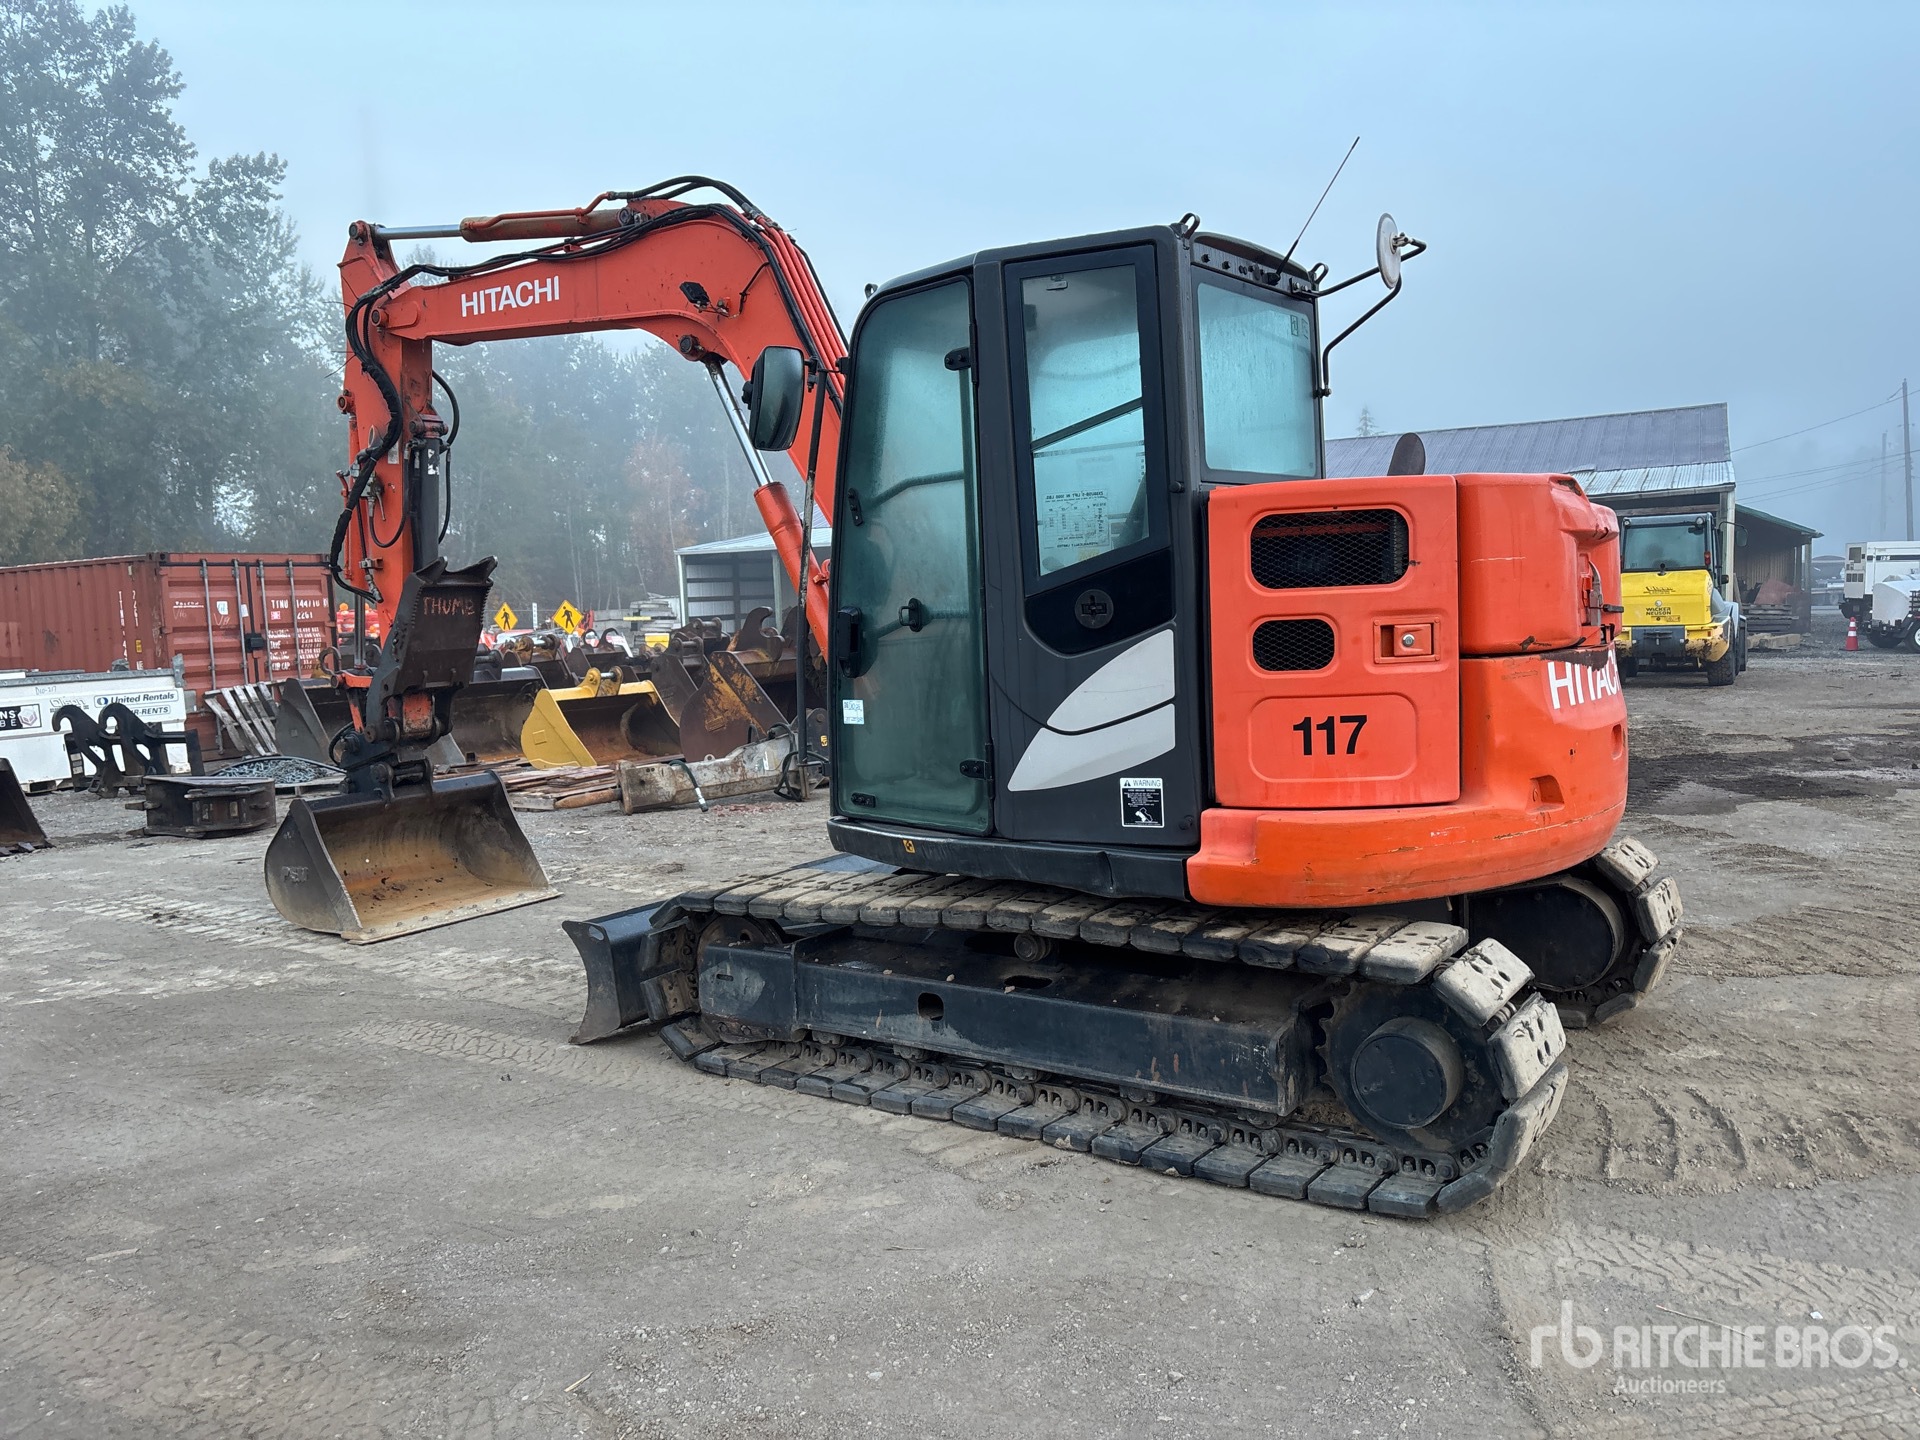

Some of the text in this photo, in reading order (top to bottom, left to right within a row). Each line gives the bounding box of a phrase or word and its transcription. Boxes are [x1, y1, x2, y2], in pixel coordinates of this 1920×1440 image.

[460, 275, 560, 318] HITACHI
[423, 596, 475, 617] THUMB
[111, 692, 175, 704] United Rentals
[1293, 715, 1368, 756] 117
[1133, 779, 1161, 787] WARNING
